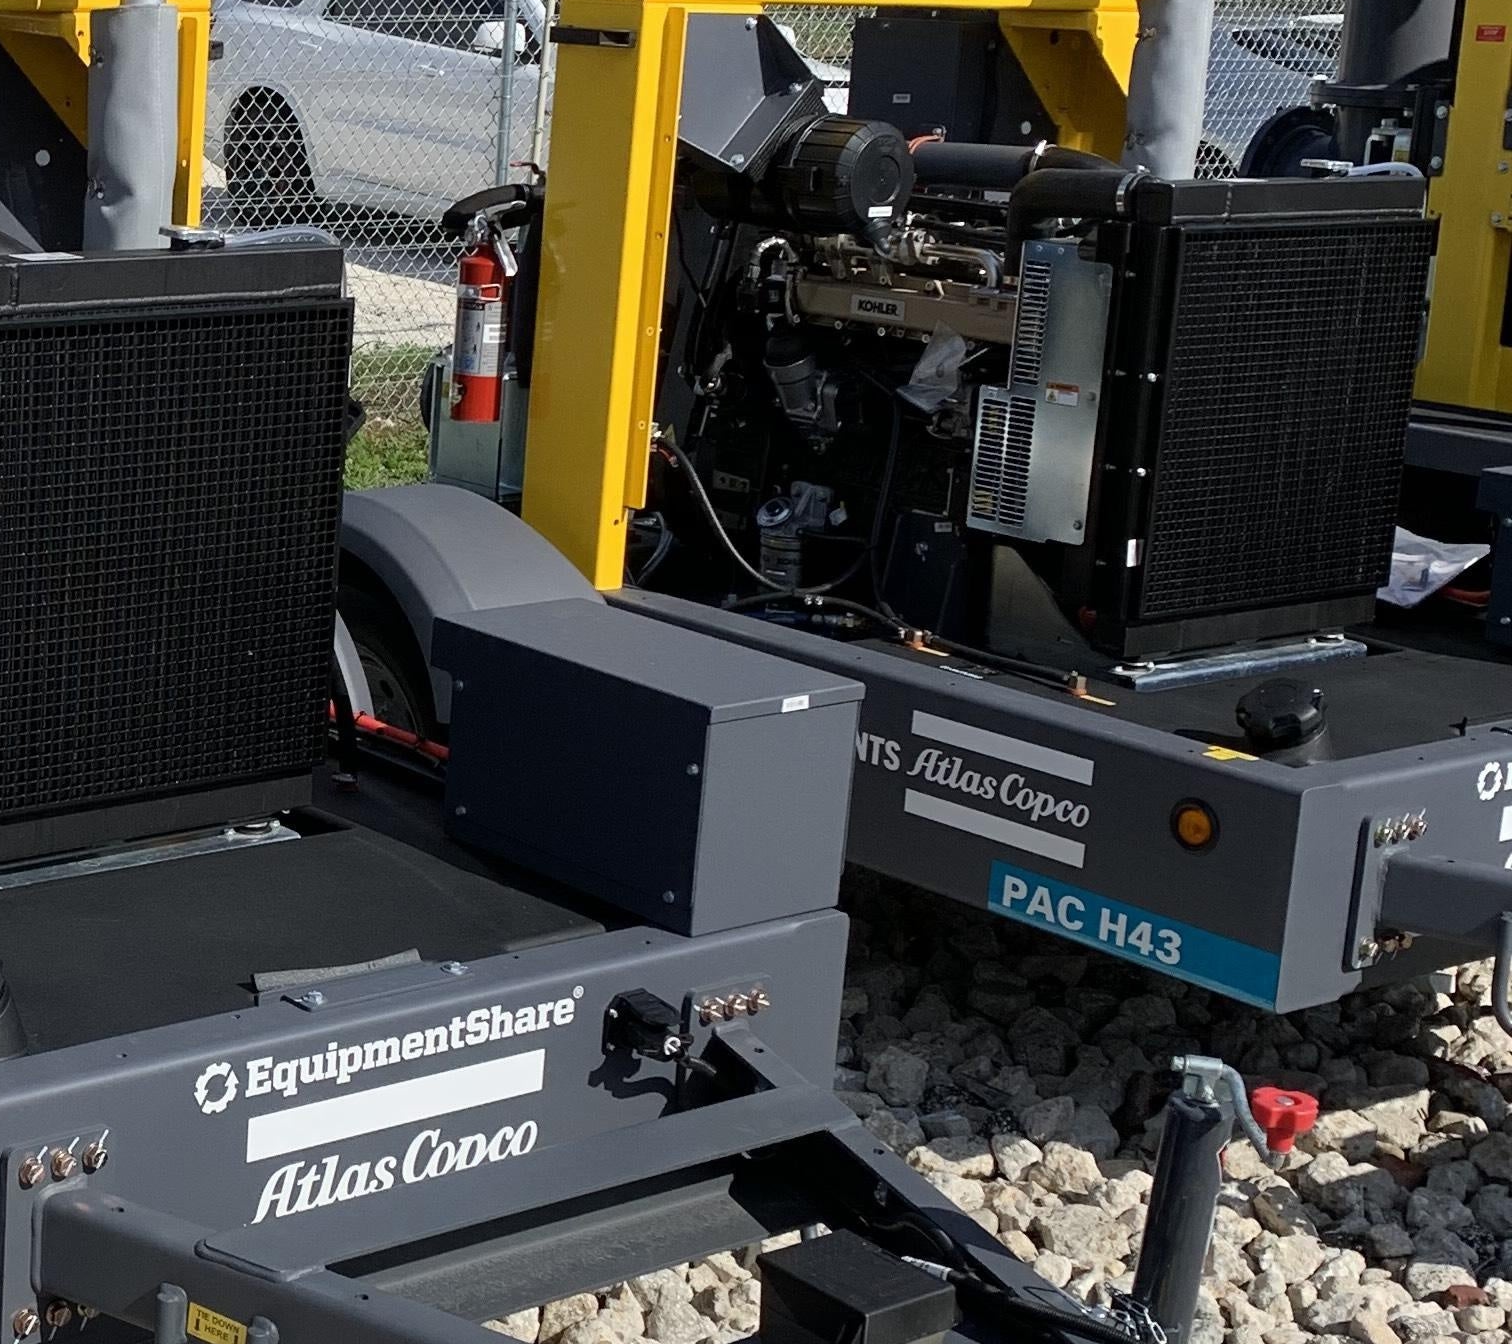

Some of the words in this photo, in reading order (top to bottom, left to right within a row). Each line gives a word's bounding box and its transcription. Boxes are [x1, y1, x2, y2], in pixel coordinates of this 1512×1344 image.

[857, 298, 899, 316] KOHLER
[854, 730, 902, 772] NTS
[906, 748, 998, 800] Atlas
[999, 773, 1090, 828] Copco
[1001, 874, 1086, 931] PAC
[1099, 907, 1182, 966] H43
[244, 1155, 398, 1226] Atlas
[402, 1120, 538, 1184] Copco
[196, 1309, 210, 1322] TIE
[212, 1316, 241, 1334] DOWN
[204, 1324, 229, 1341] HERE
